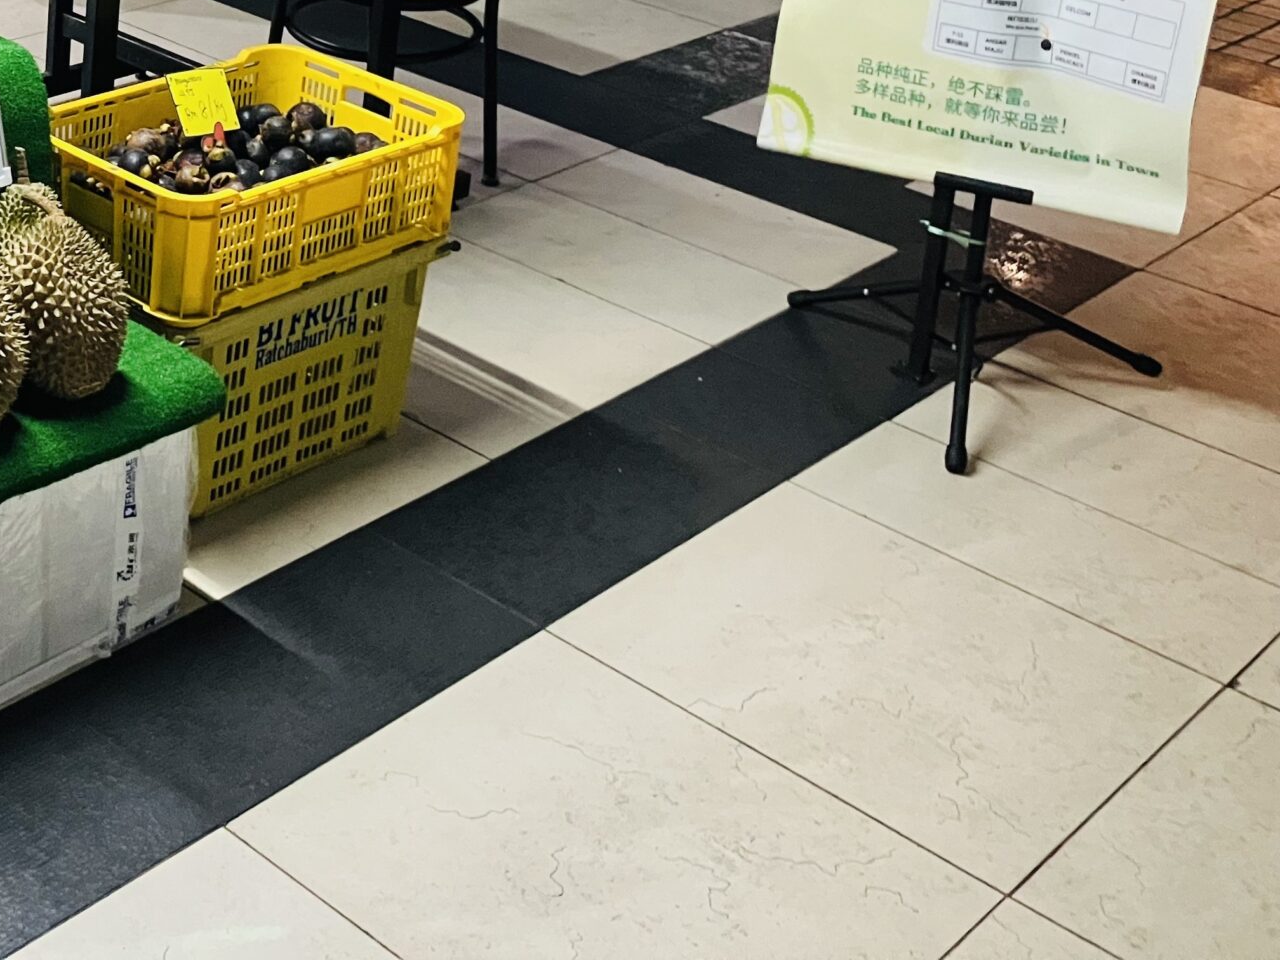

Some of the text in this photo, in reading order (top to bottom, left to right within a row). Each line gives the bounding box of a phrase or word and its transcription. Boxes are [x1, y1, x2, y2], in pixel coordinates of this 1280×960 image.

[852, 105, 1160, 178] The Best Local Durian Varieties in Town
[255, 314, 357, 370] Ratchaburi/TH
